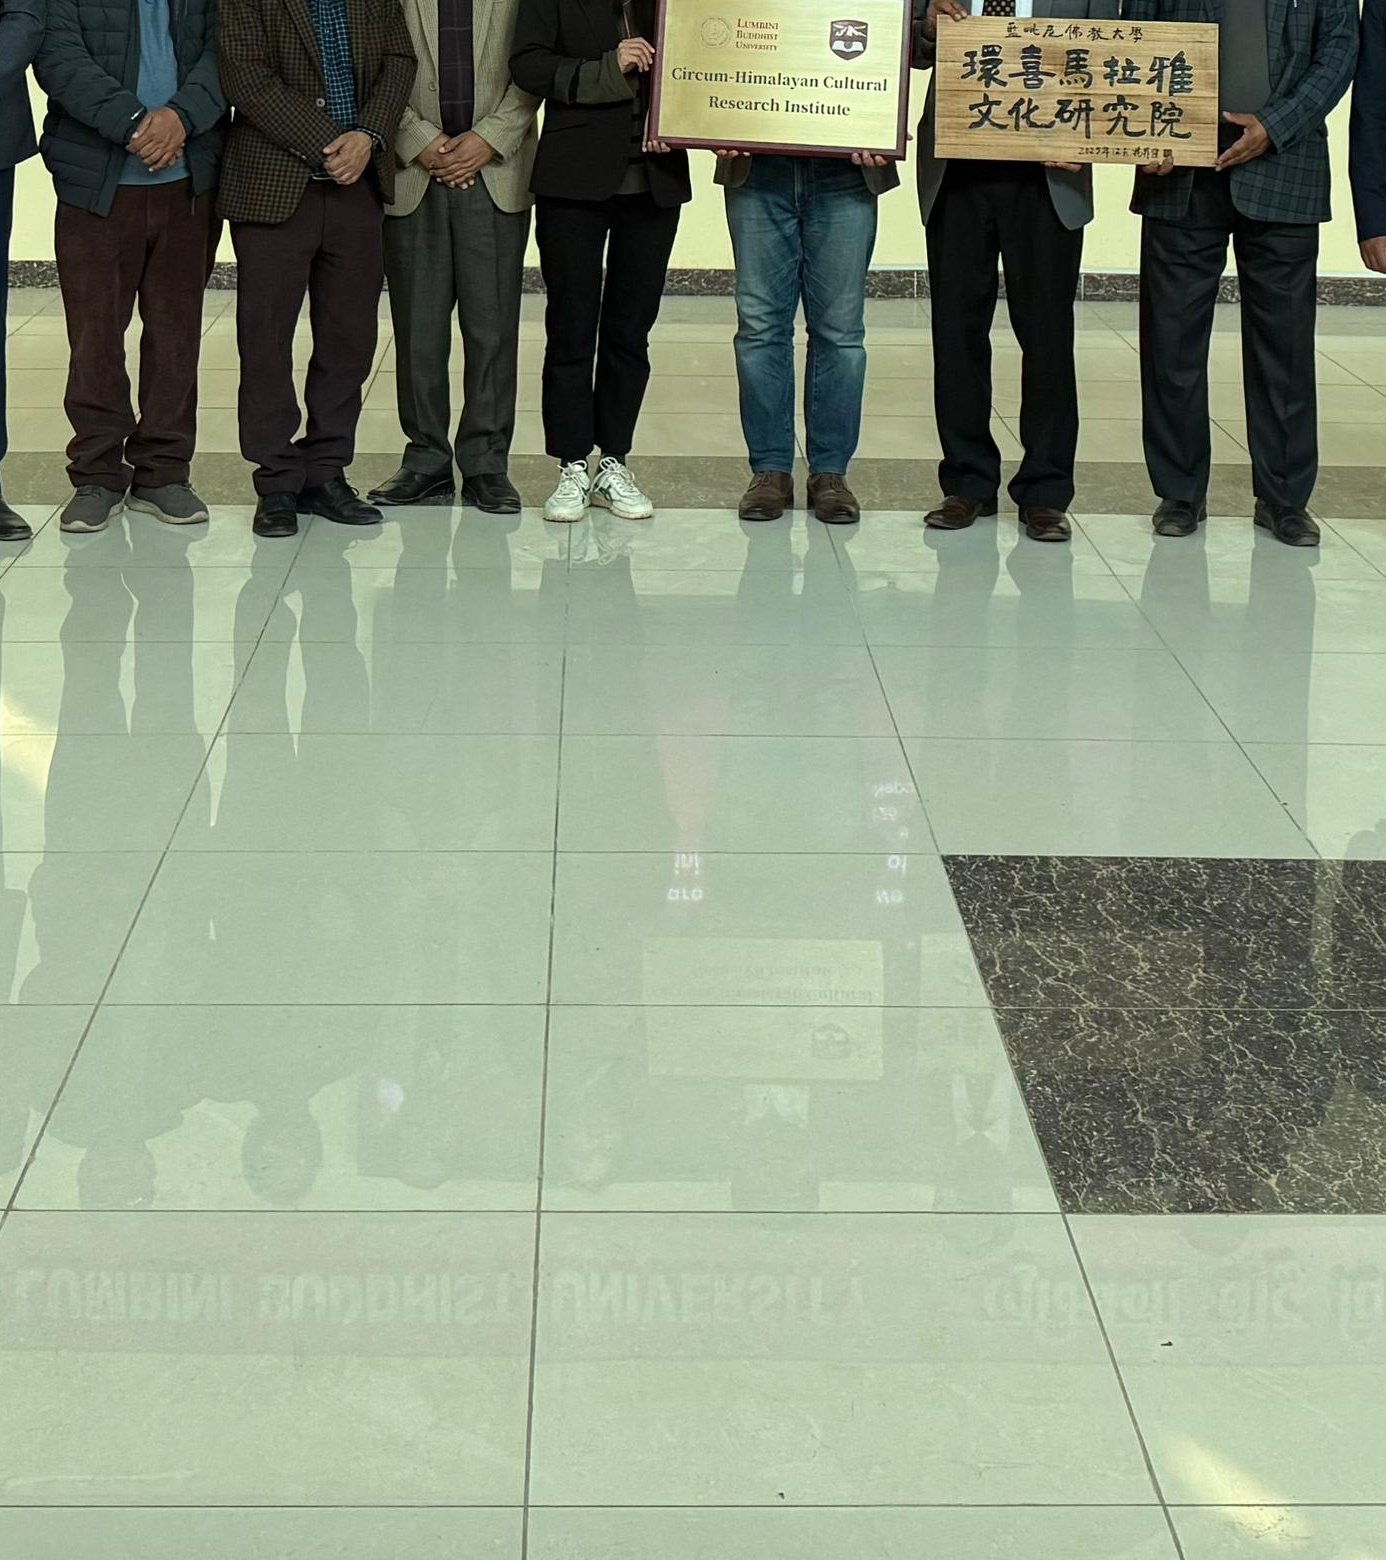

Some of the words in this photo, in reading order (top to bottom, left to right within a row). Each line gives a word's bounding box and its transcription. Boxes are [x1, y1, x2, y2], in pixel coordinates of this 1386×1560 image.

[671, 67, 819, 90] Circum-Himalayan
[823, 75, 888, 92] Cultural
[960, 43, 1195, 98] 環喜馬拉雅
[709, 95, 780, 112] Research
[785, 100, 851, 117] Institute
[968, 92, 1193, 140] 文化研究院
